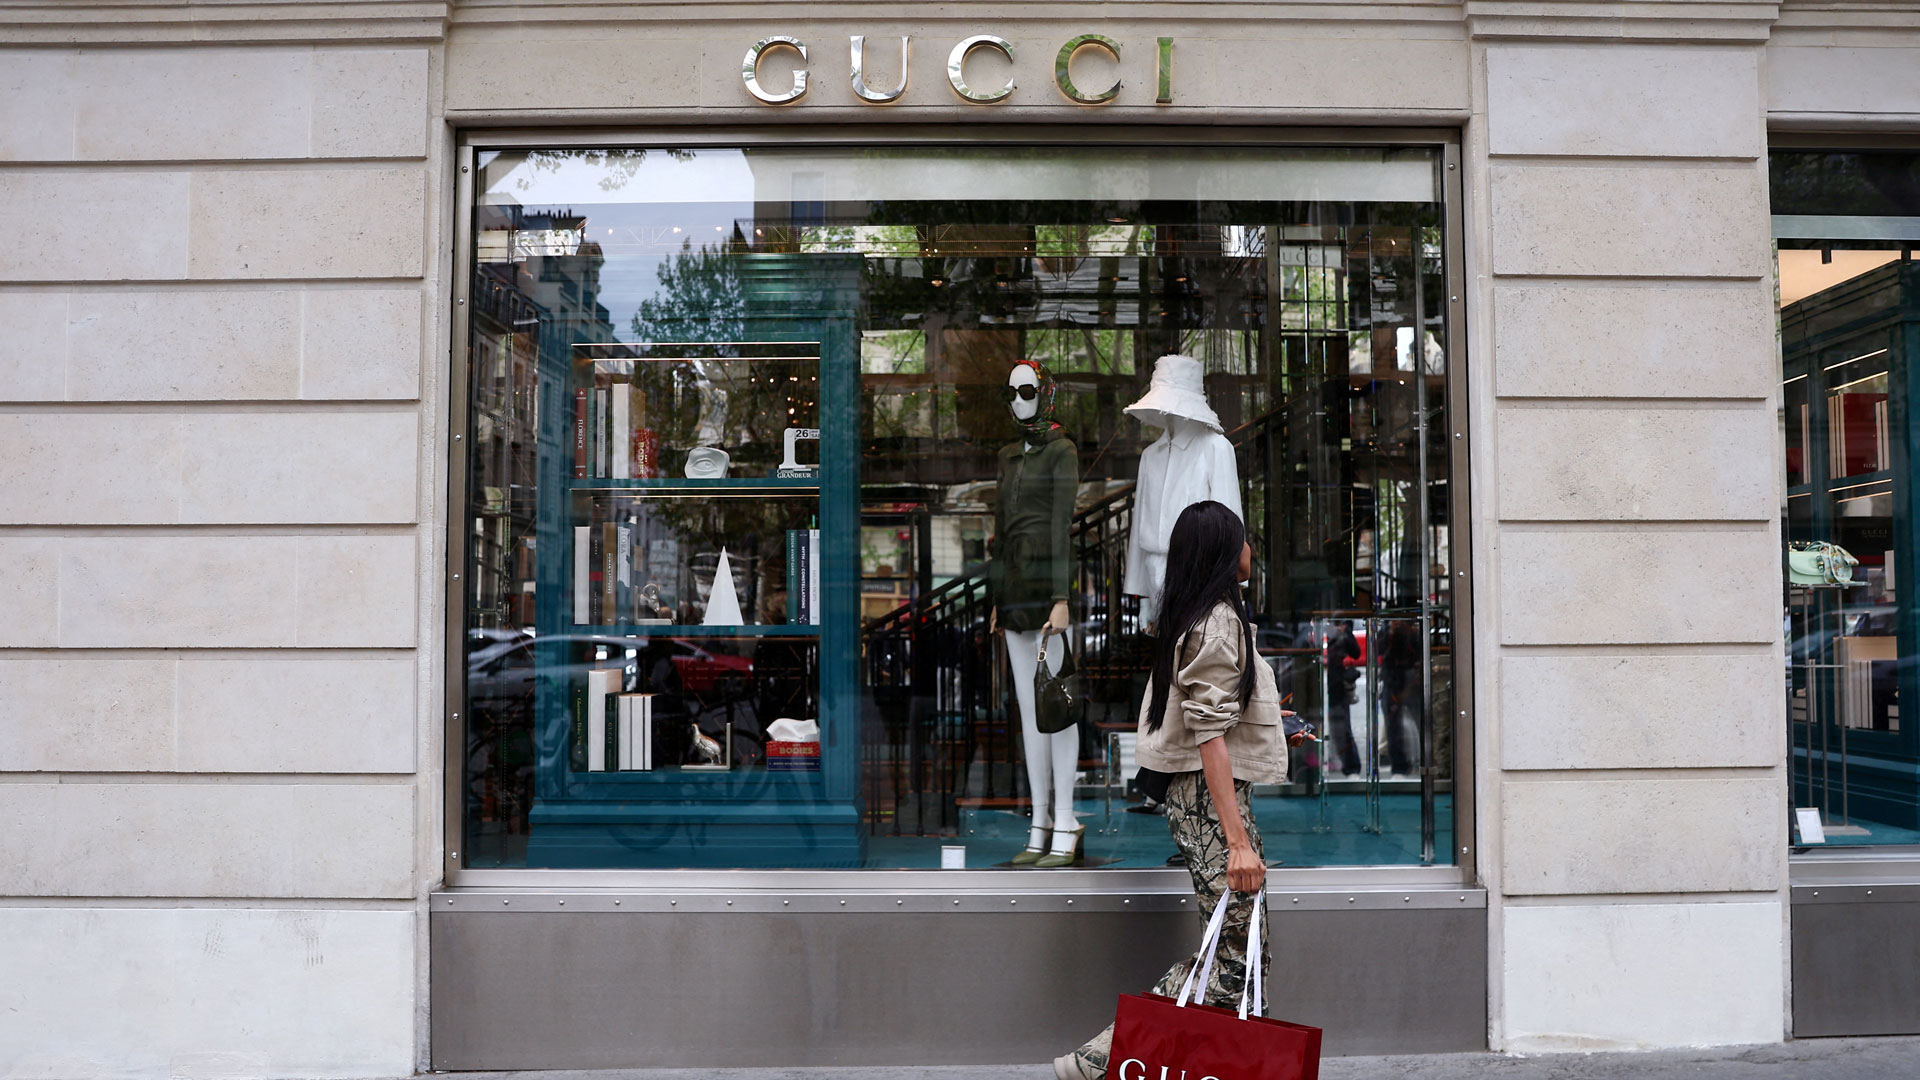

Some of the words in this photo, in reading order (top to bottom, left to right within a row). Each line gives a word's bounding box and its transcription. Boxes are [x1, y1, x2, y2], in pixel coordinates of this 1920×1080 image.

[742, 34, 1175, 105] GUCCI
[796, 429, 809, 438] 26
[637, 441, 645, 475] BODIES
[1119, 1058, 1220, 1080] GU
